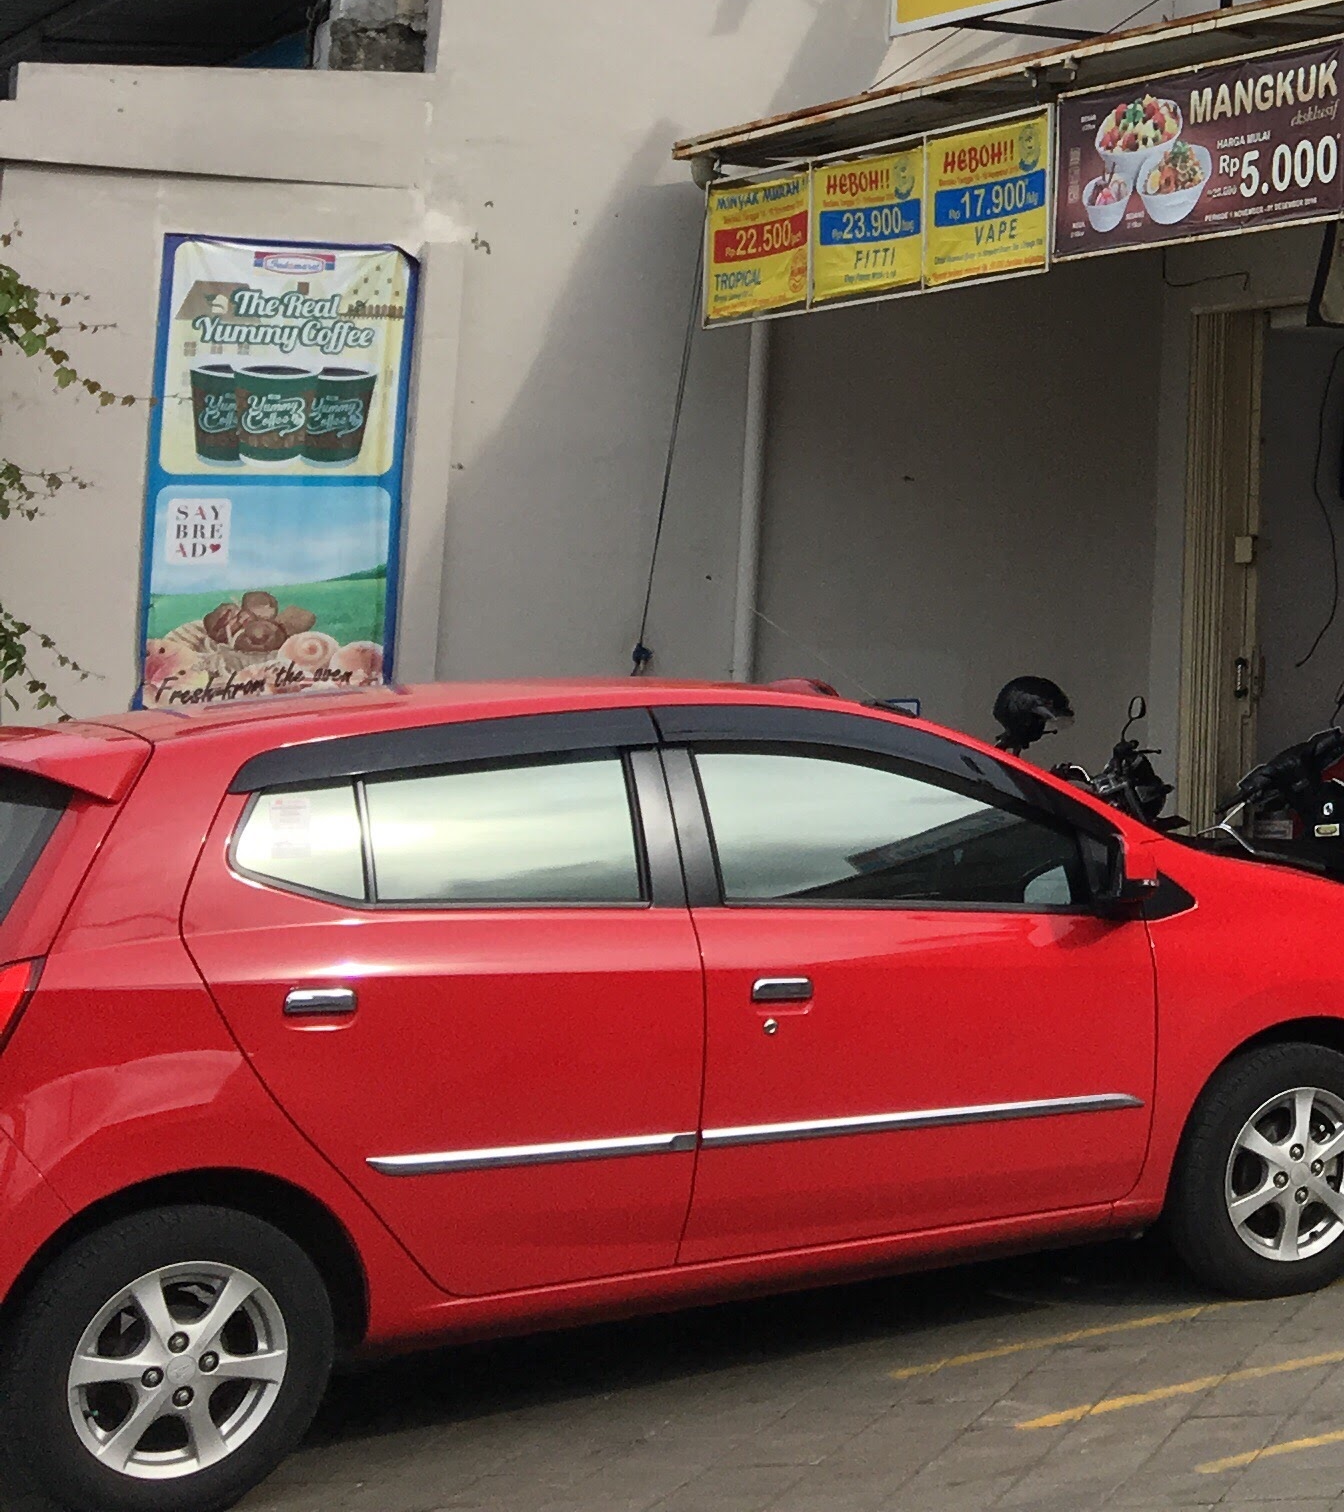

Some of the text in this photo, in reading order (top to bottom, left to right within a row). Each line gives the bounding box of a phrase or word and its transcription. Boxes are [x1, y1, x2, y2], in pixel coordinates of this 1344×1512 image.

[1189, 59, 1338, 125] MANGKUK
[1216, 134, 1245, 150] HARGA
[943, 139, 1014, 175] HEBOH!!
[1218, 135, 1338, 198] Rp 5.000
[826, 168, 890, 198] HEBOH!!
[960, 180, 1026, 219] 17.900
[842, 206, 901, 240] 23.900
[974, 218, 1019, 246] VAPE
[736, 220, 791, 256] 22.500
[853, 247, 896, 270] FITTI
[713, 267, 762, 291] TROPICAL
[233, 289, 340, 318] The Real
[194, 316, 374, 353] Yummy Coffee
[247, 394, 298, 414] Yummy
[245, 409, 290, 430] Coffee
[175, 504, 224, 522] SAY
[175, 523, 224, 540] BRE
[175, 542, 208, 558] AD
[154, 670, 221, 705] Fresh
[274, 660, 305, 688] the
[313, 667, 353, 684] oven
